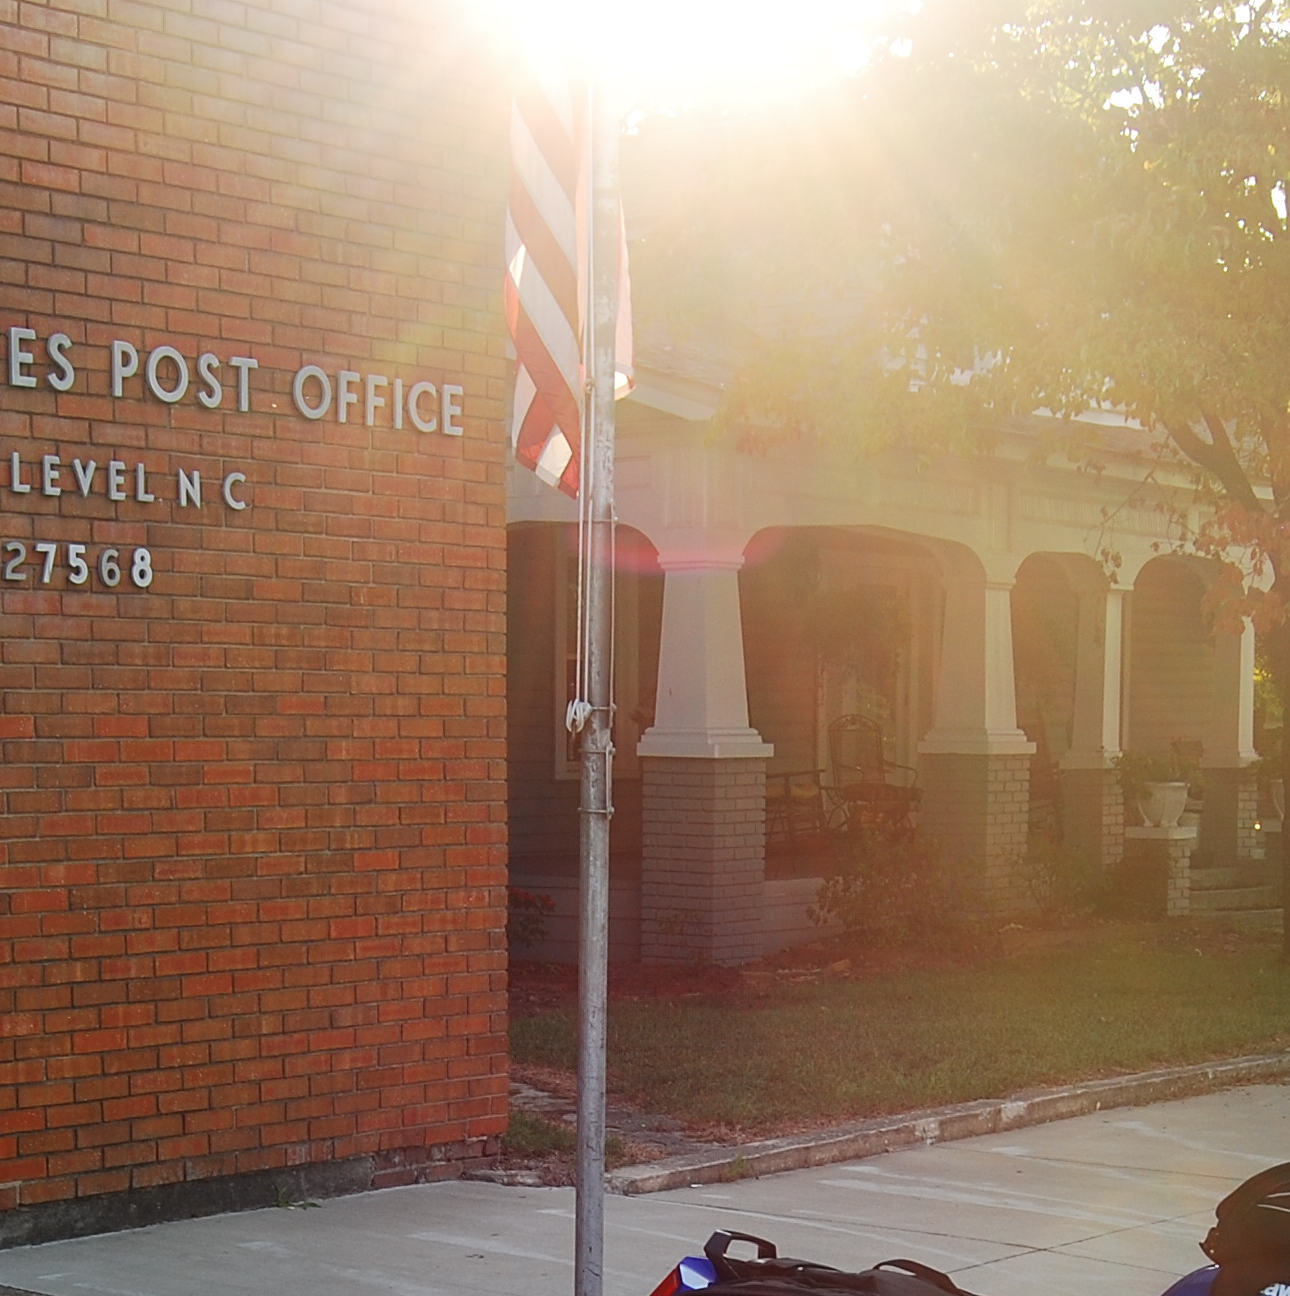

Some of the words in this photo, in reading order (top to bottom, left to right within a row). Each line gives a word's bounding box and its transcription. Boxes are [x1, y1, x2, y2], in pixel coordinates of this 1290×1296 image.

[112, 340, 259, 412] POST
[293, 365, 464, 436] OFFICE
[11, 452, 155, 502] LEVEL
[4, 541, 153, 588] 27568
